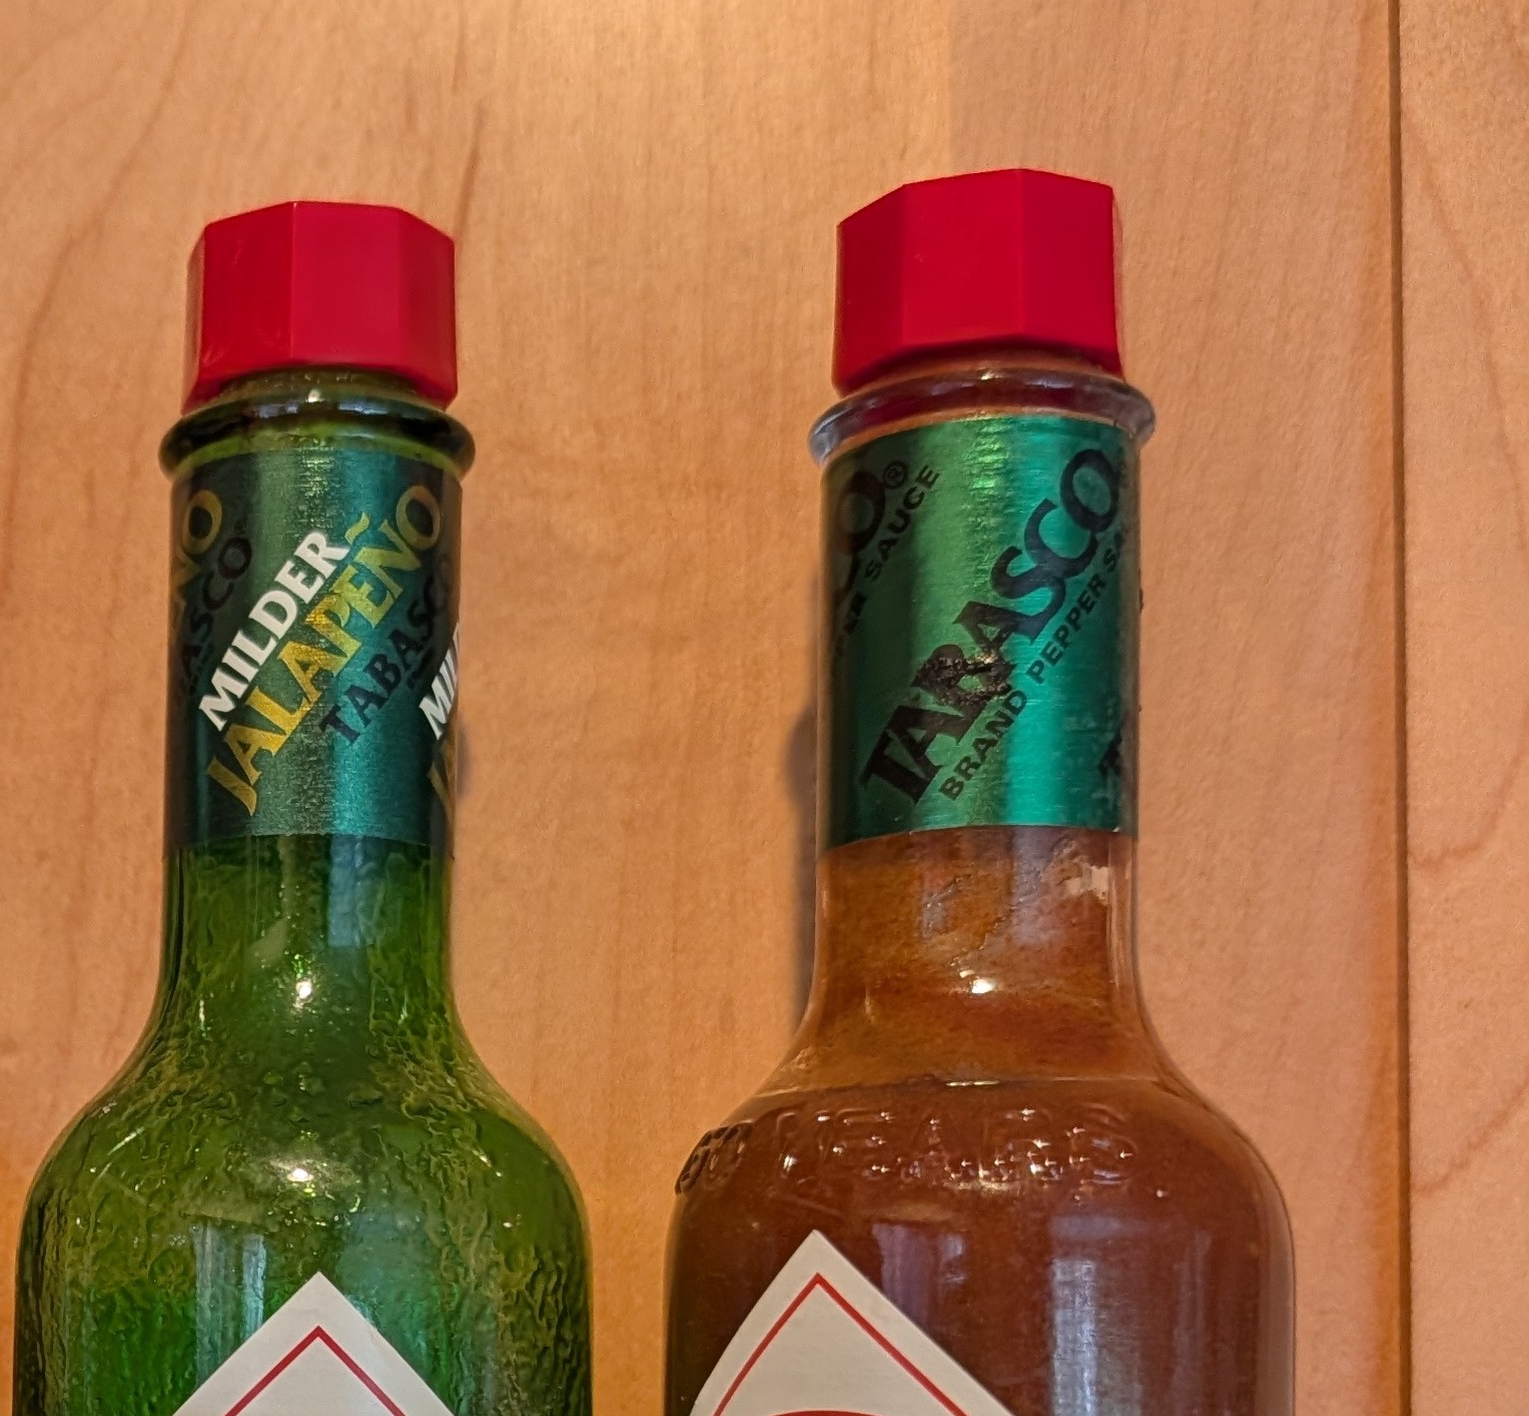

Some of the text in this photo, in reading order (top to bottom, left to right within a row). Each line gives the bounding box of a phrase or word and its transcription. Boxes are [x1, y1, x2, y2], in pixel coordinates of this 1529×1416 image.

[199, 529, 350, 732] MILDER
[860, 448, 1119, 804] TABASCO
[867, 464, 940, 583] SAUCE
[207, 484, 440, 817] JALAPEÑO
[319, 555, 447, 746] TABASC
[937, 574, 1107, 802] BRAND PEPPER
